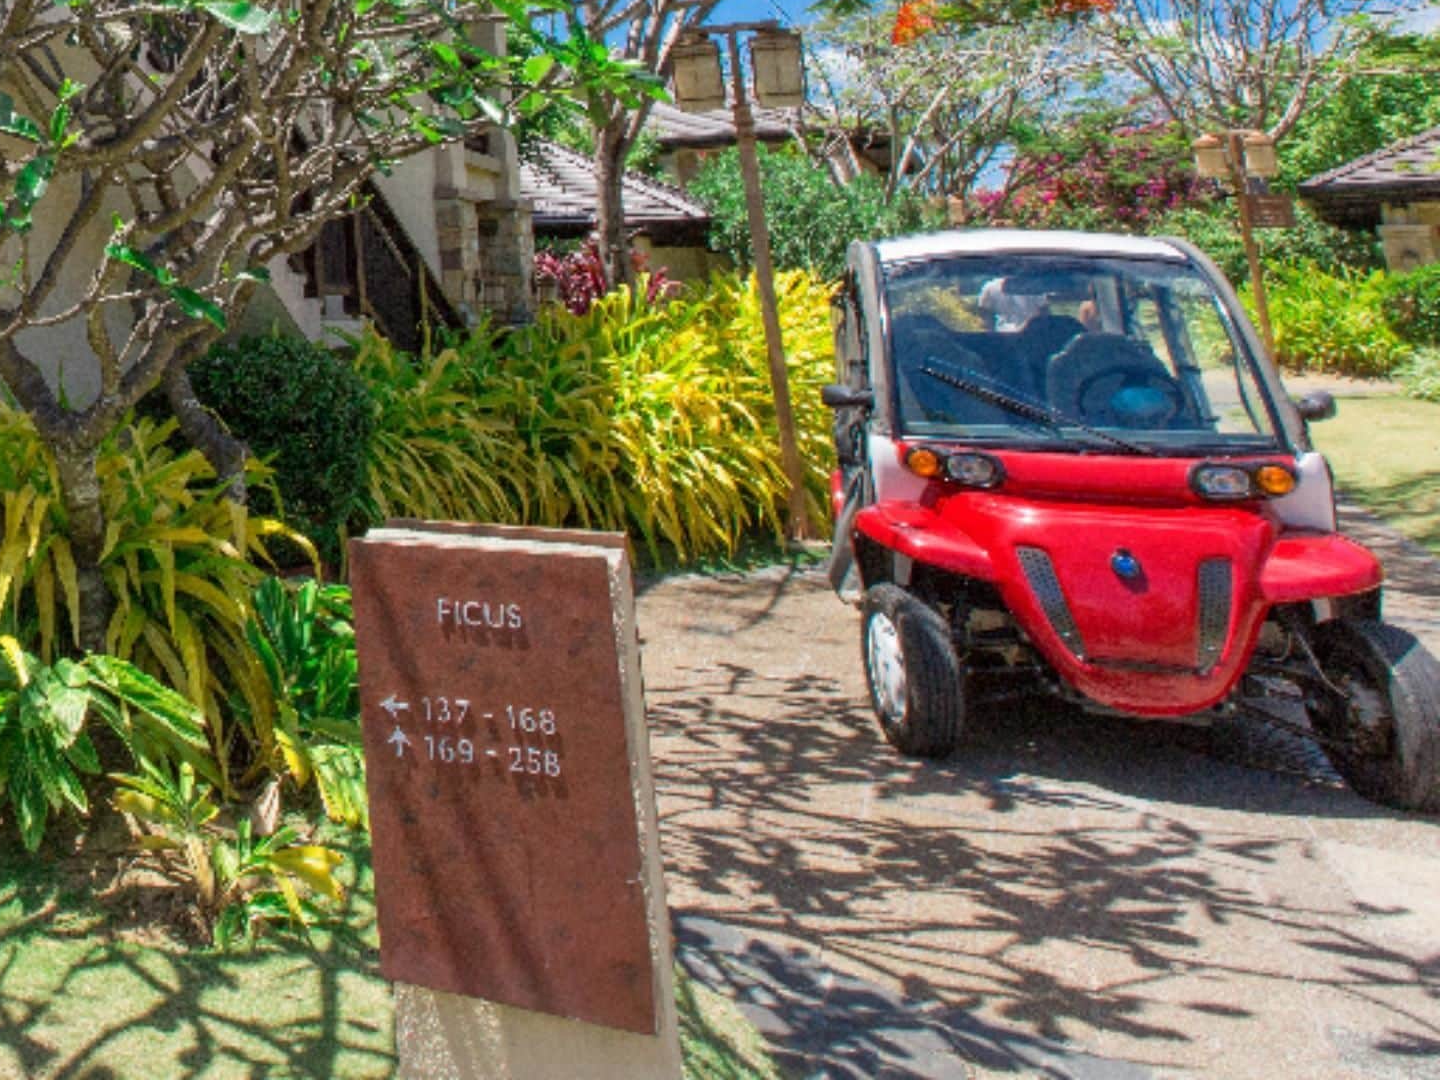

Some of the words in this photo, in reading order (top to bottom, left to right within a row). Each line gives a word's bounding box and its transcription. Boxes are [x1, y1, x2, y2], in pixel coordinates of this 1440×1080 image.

[437, 597, 522, 629] FICUS
[421, 696, 471, 724] 137
[505, 704, 557, 736] 168
[423, 735, 474, 764] 169
